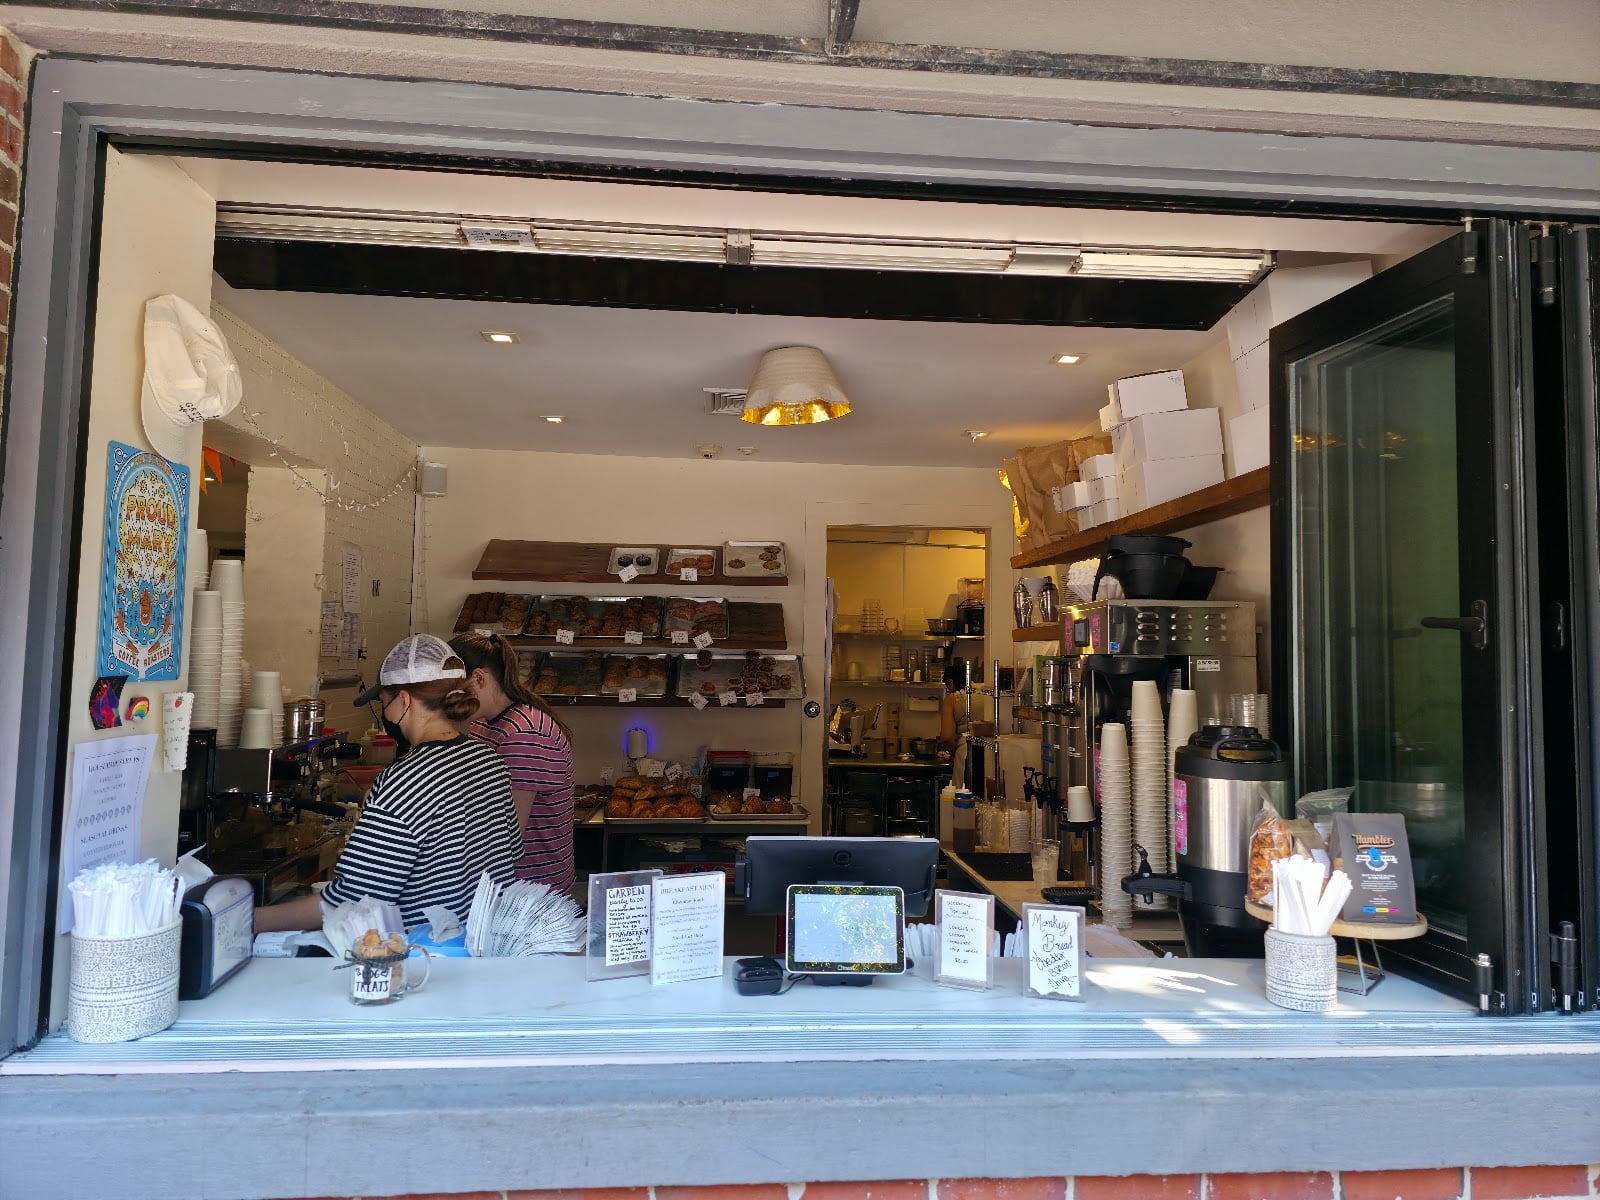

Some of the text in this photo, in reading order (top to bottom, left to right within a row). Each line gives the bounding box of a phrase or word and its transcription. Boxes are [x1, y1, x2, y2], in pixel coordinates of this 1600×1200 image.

[126, 494, 176, 529] PROUD
[126, 527, 174, 553] MARY
[118, 647, 171, 668] COFFEE ROASTERS
[1353, 834, 1395, 848] Humbler
[608, 886, 645, 898] GARDEN
[660, 885, 697, 895] BREAKFAST
[1032, 912, 1070, 937] Monkey
[608, 929, 649, 939] STRAWBERRY
[1042, 933, 1073, 953] Bread
[355, 980, 389, 993] TREATS
